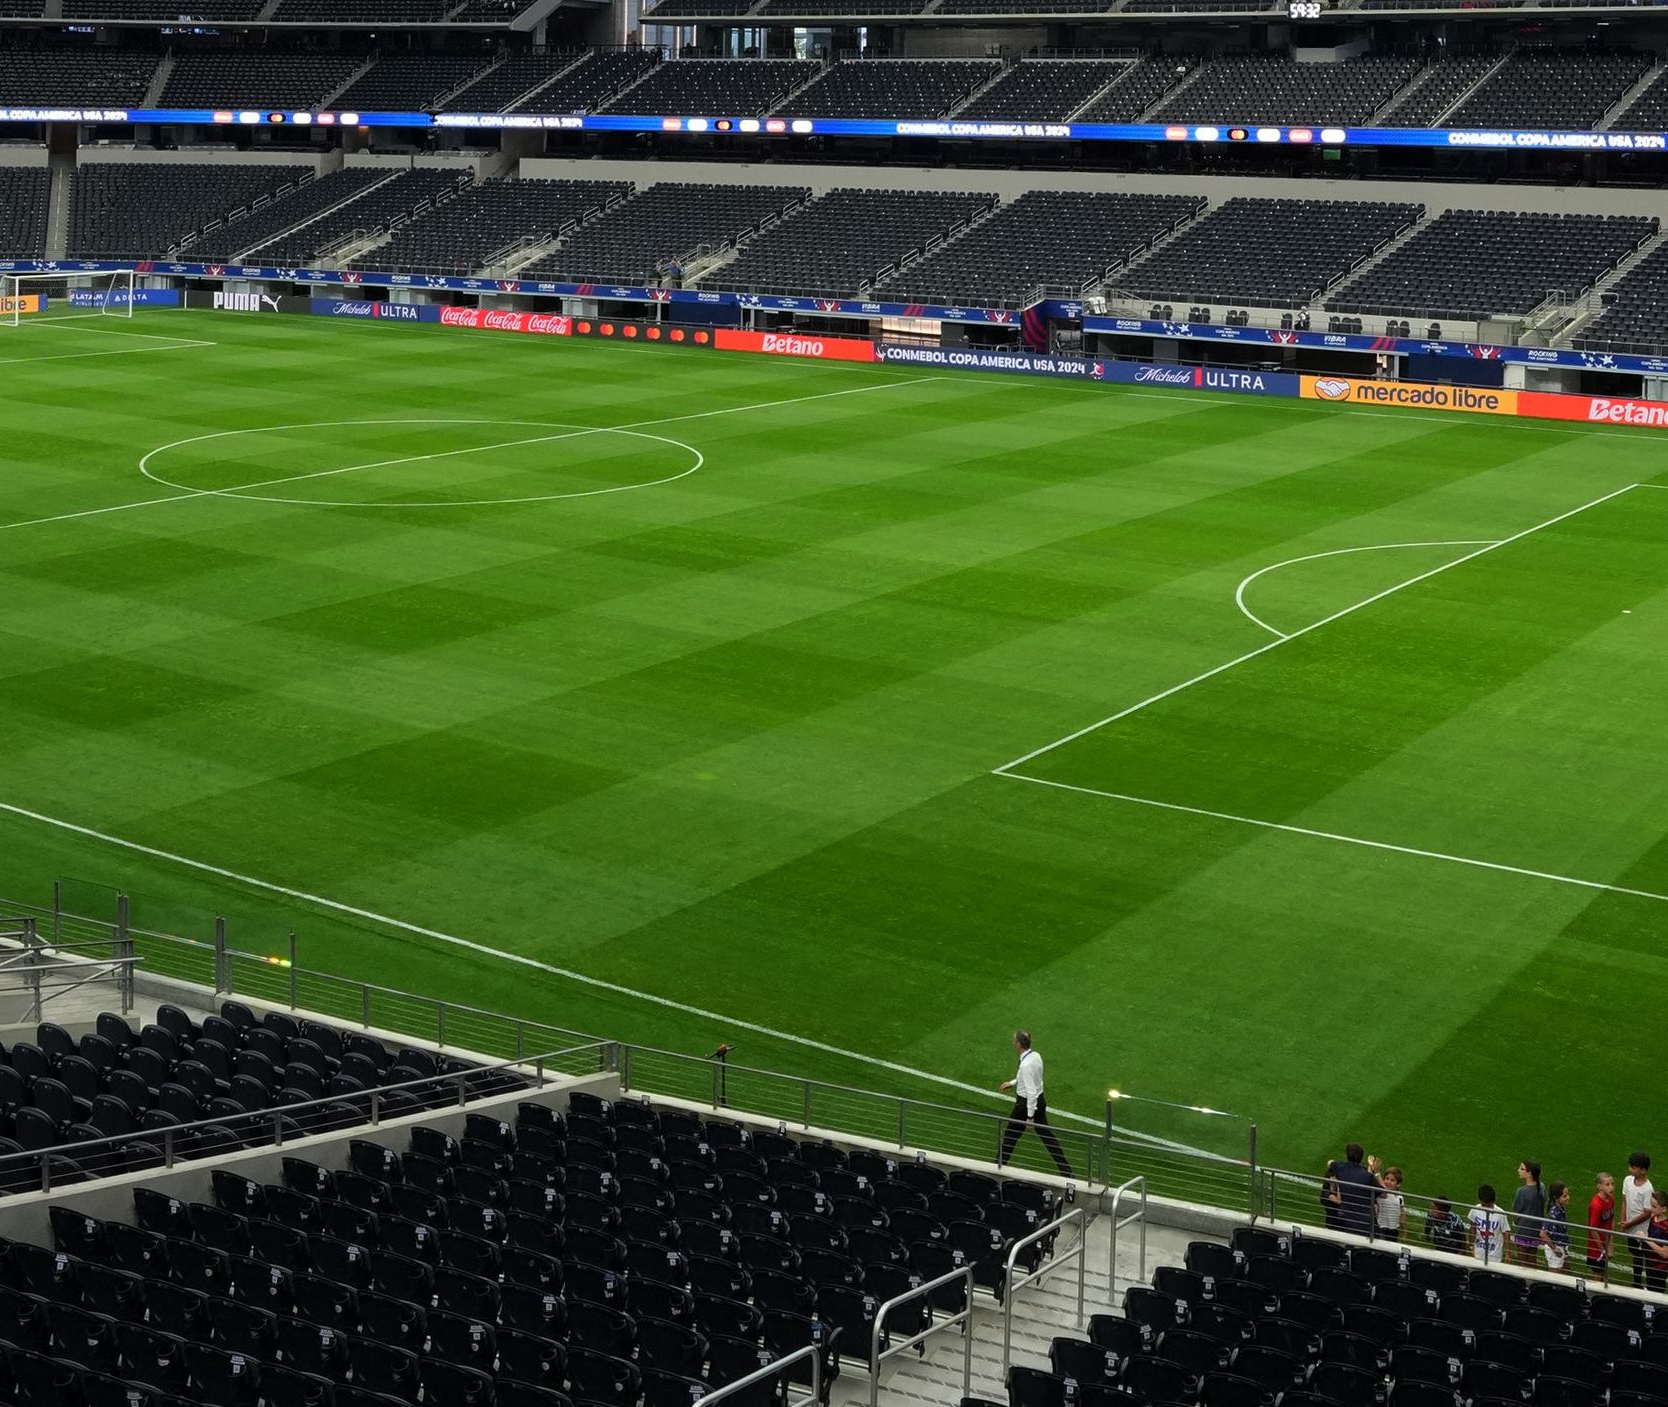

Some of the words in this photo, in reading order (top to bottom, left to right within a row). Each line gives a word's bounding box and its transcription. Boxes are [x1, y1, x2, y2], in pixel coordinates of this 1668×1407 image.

[213, 291, 260, 312] PUMA
[332, 302, 372, 316] Michelob
[380, 303, 417, 319] ULTRA
[440, 308, 478, 326] Coca-Cola
[484, 312, 522, 330] Coca-Cola
[528, 315, 568, 333] Coca-Cola
[762, 333, 824, 356] Betano
[887, 347, 947, 363] CONMEBOL
[949, 352, 980, 365] COPA
[980, 354, 1031, 370] AMERICA
[1033, 358, 1056, 372] USA
[1057, 360, 1085, 374] 2024
[1134, 366, 1191, 384] Michelob
[1206, 372, 1266, 390] ULTRA
[1357, 383, 1448, 407] mercado
[1452, 386, 1499, 411] libre
